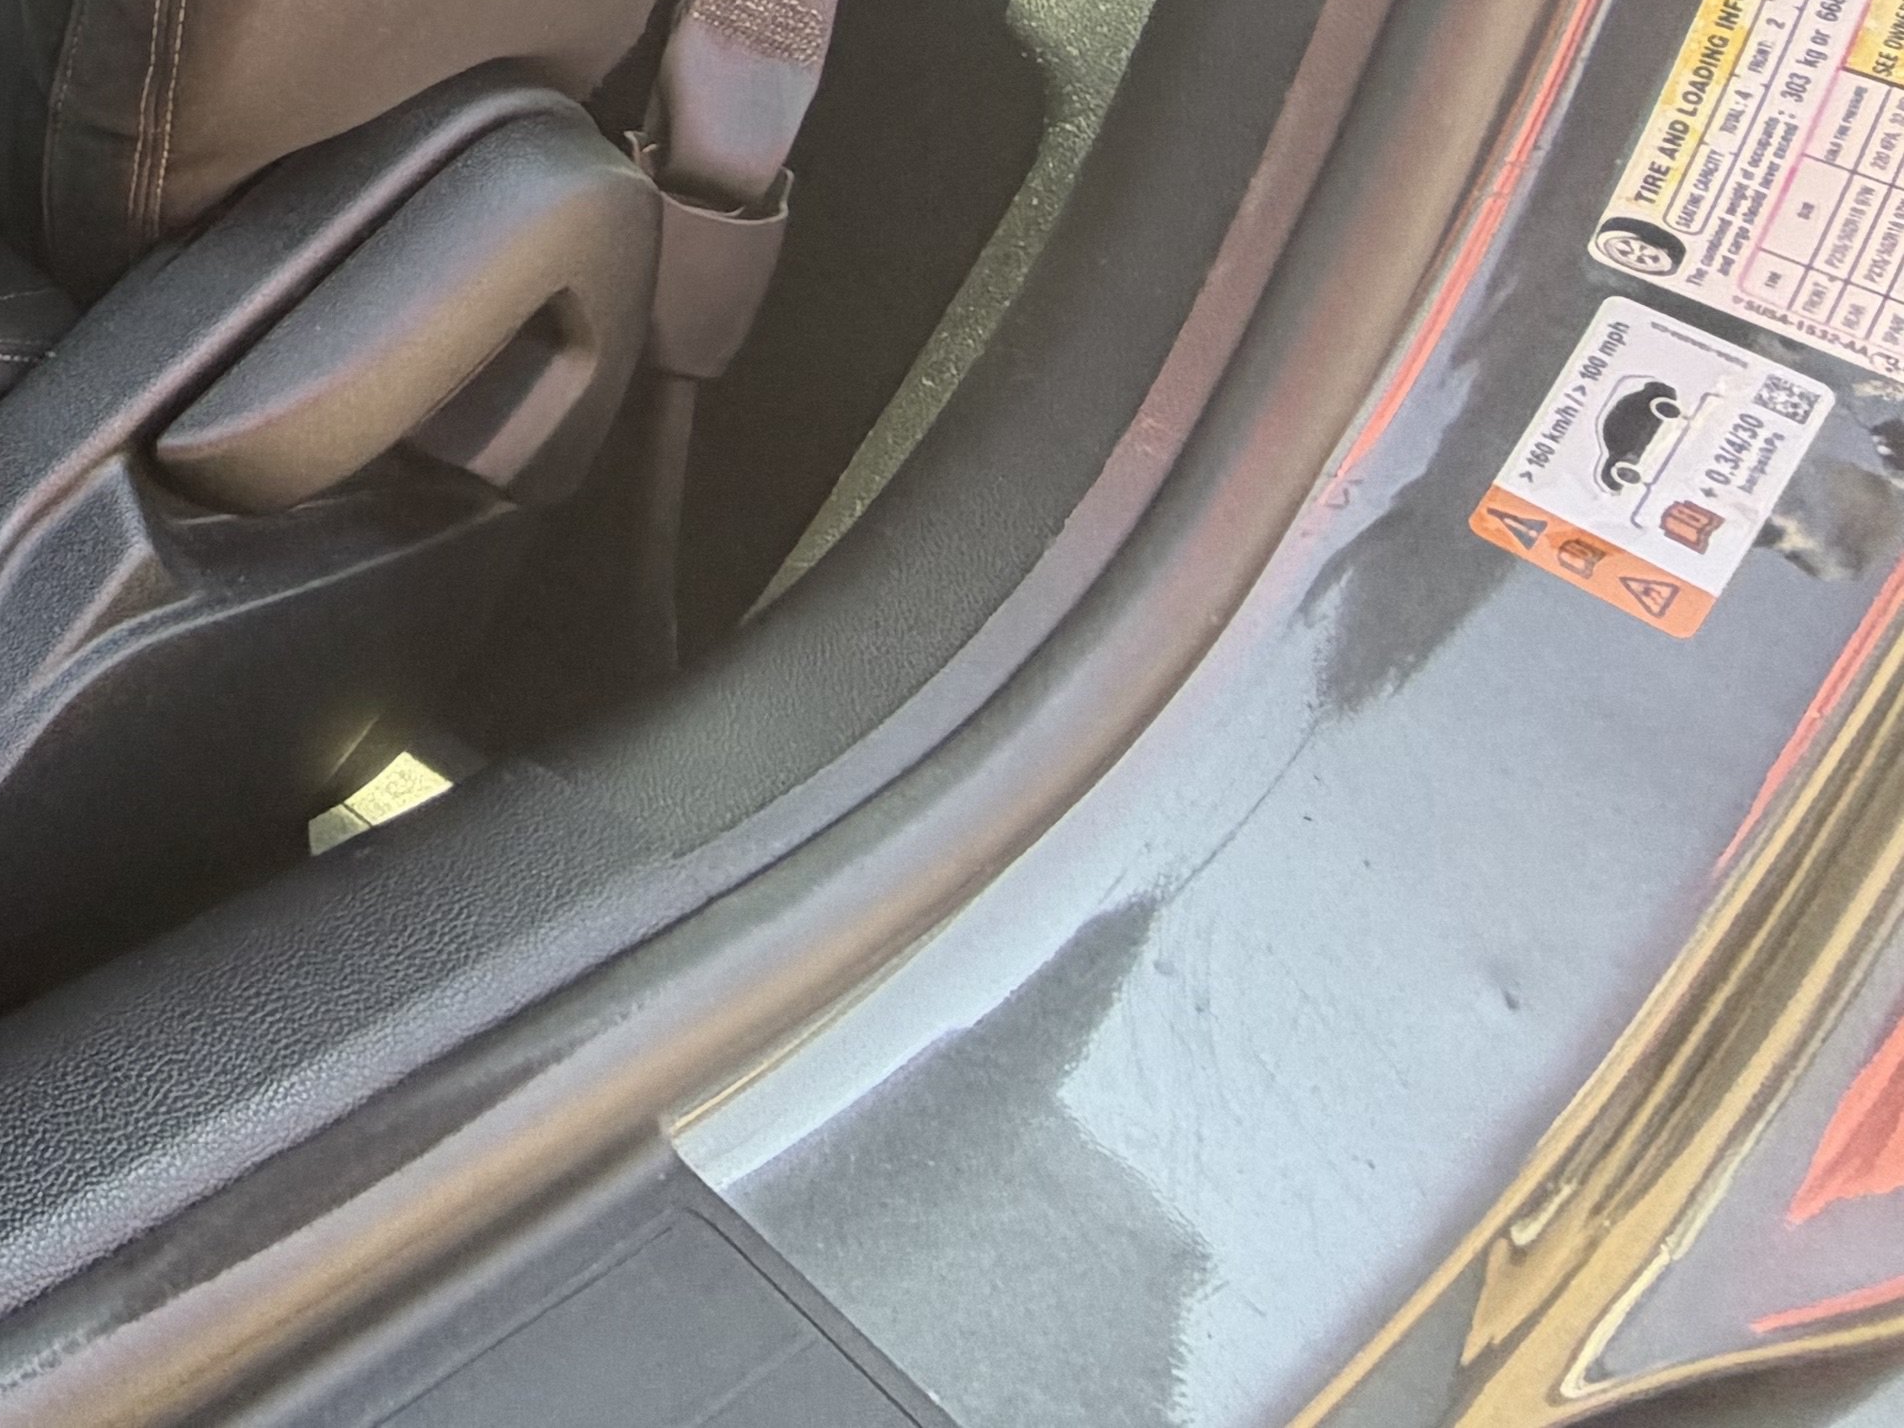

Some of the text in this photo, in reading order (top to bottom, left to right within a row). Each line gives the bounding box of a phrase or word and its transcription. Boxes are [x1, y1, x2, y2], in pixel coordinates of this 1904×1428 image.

[1733, 89, 1753, 100] 4
[1765, 17, 1785, 29] 2
[1795, 48, 1828, 68] kg
[1809, 28, 1830, 46] or
[1780, 72, 1811, 102] 303
[1872, 50, 1899, 77] SEE
[1633, 161, 1670, 203] TIRE
[1657, 119, 1689, 160] AND
[1677, 34, 1728, 116] LOADING
[1526, 441, 1555, 468] 160
[1541, 405, 1578, 443] km/h
[1579, 355, 1608, 381] 100
[1598, 321, 1629, 356] mph
[1705, 413, 1763, 485] 0.3/4/30
